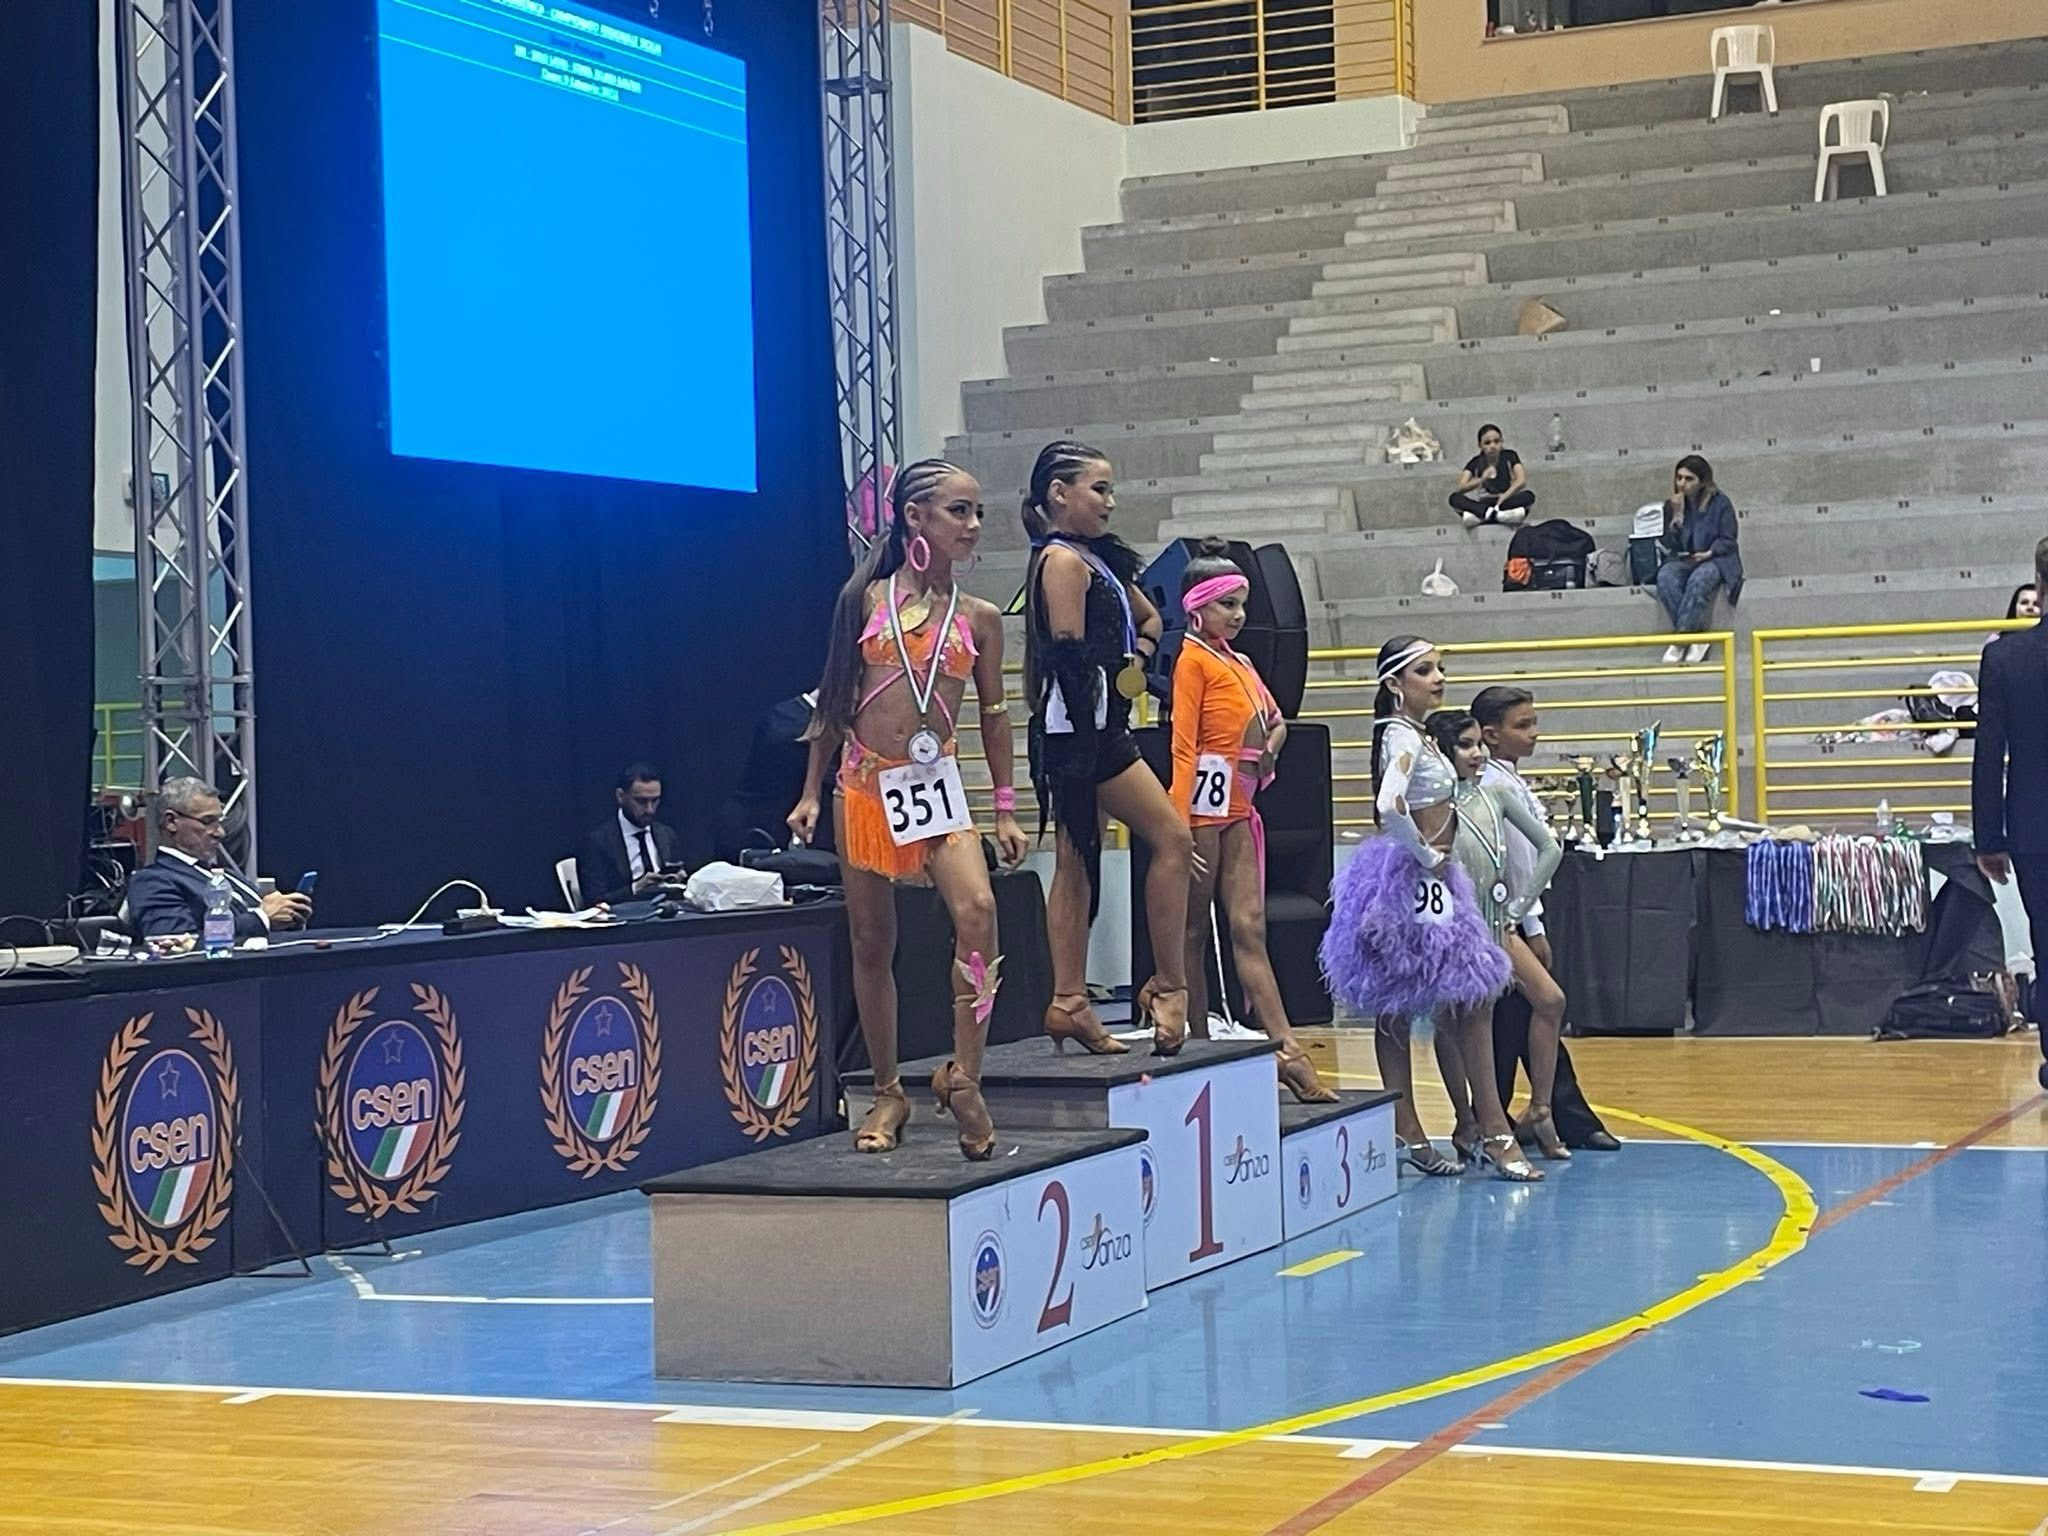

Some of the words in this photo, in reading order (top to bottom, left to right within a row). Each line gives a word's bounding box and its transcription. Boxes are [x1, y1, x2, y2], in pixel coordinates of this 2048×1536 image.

[885, 778, 953, 832] 351
[1192, 770, 1225, 807] 78
[1414, 880, 1443, 914] 98
[744, 1025, 796, 1066] csen
[570, 1049, 635, 1096] csen
[352, 1079, 432, 1130] csen
[129, 1113, 209, 1173] csen
[1336, 1126, 1350, 1208] 3
[1185, 1080, 1224, 1263] 1
[1037, 1181, 1074, 1333] 2
